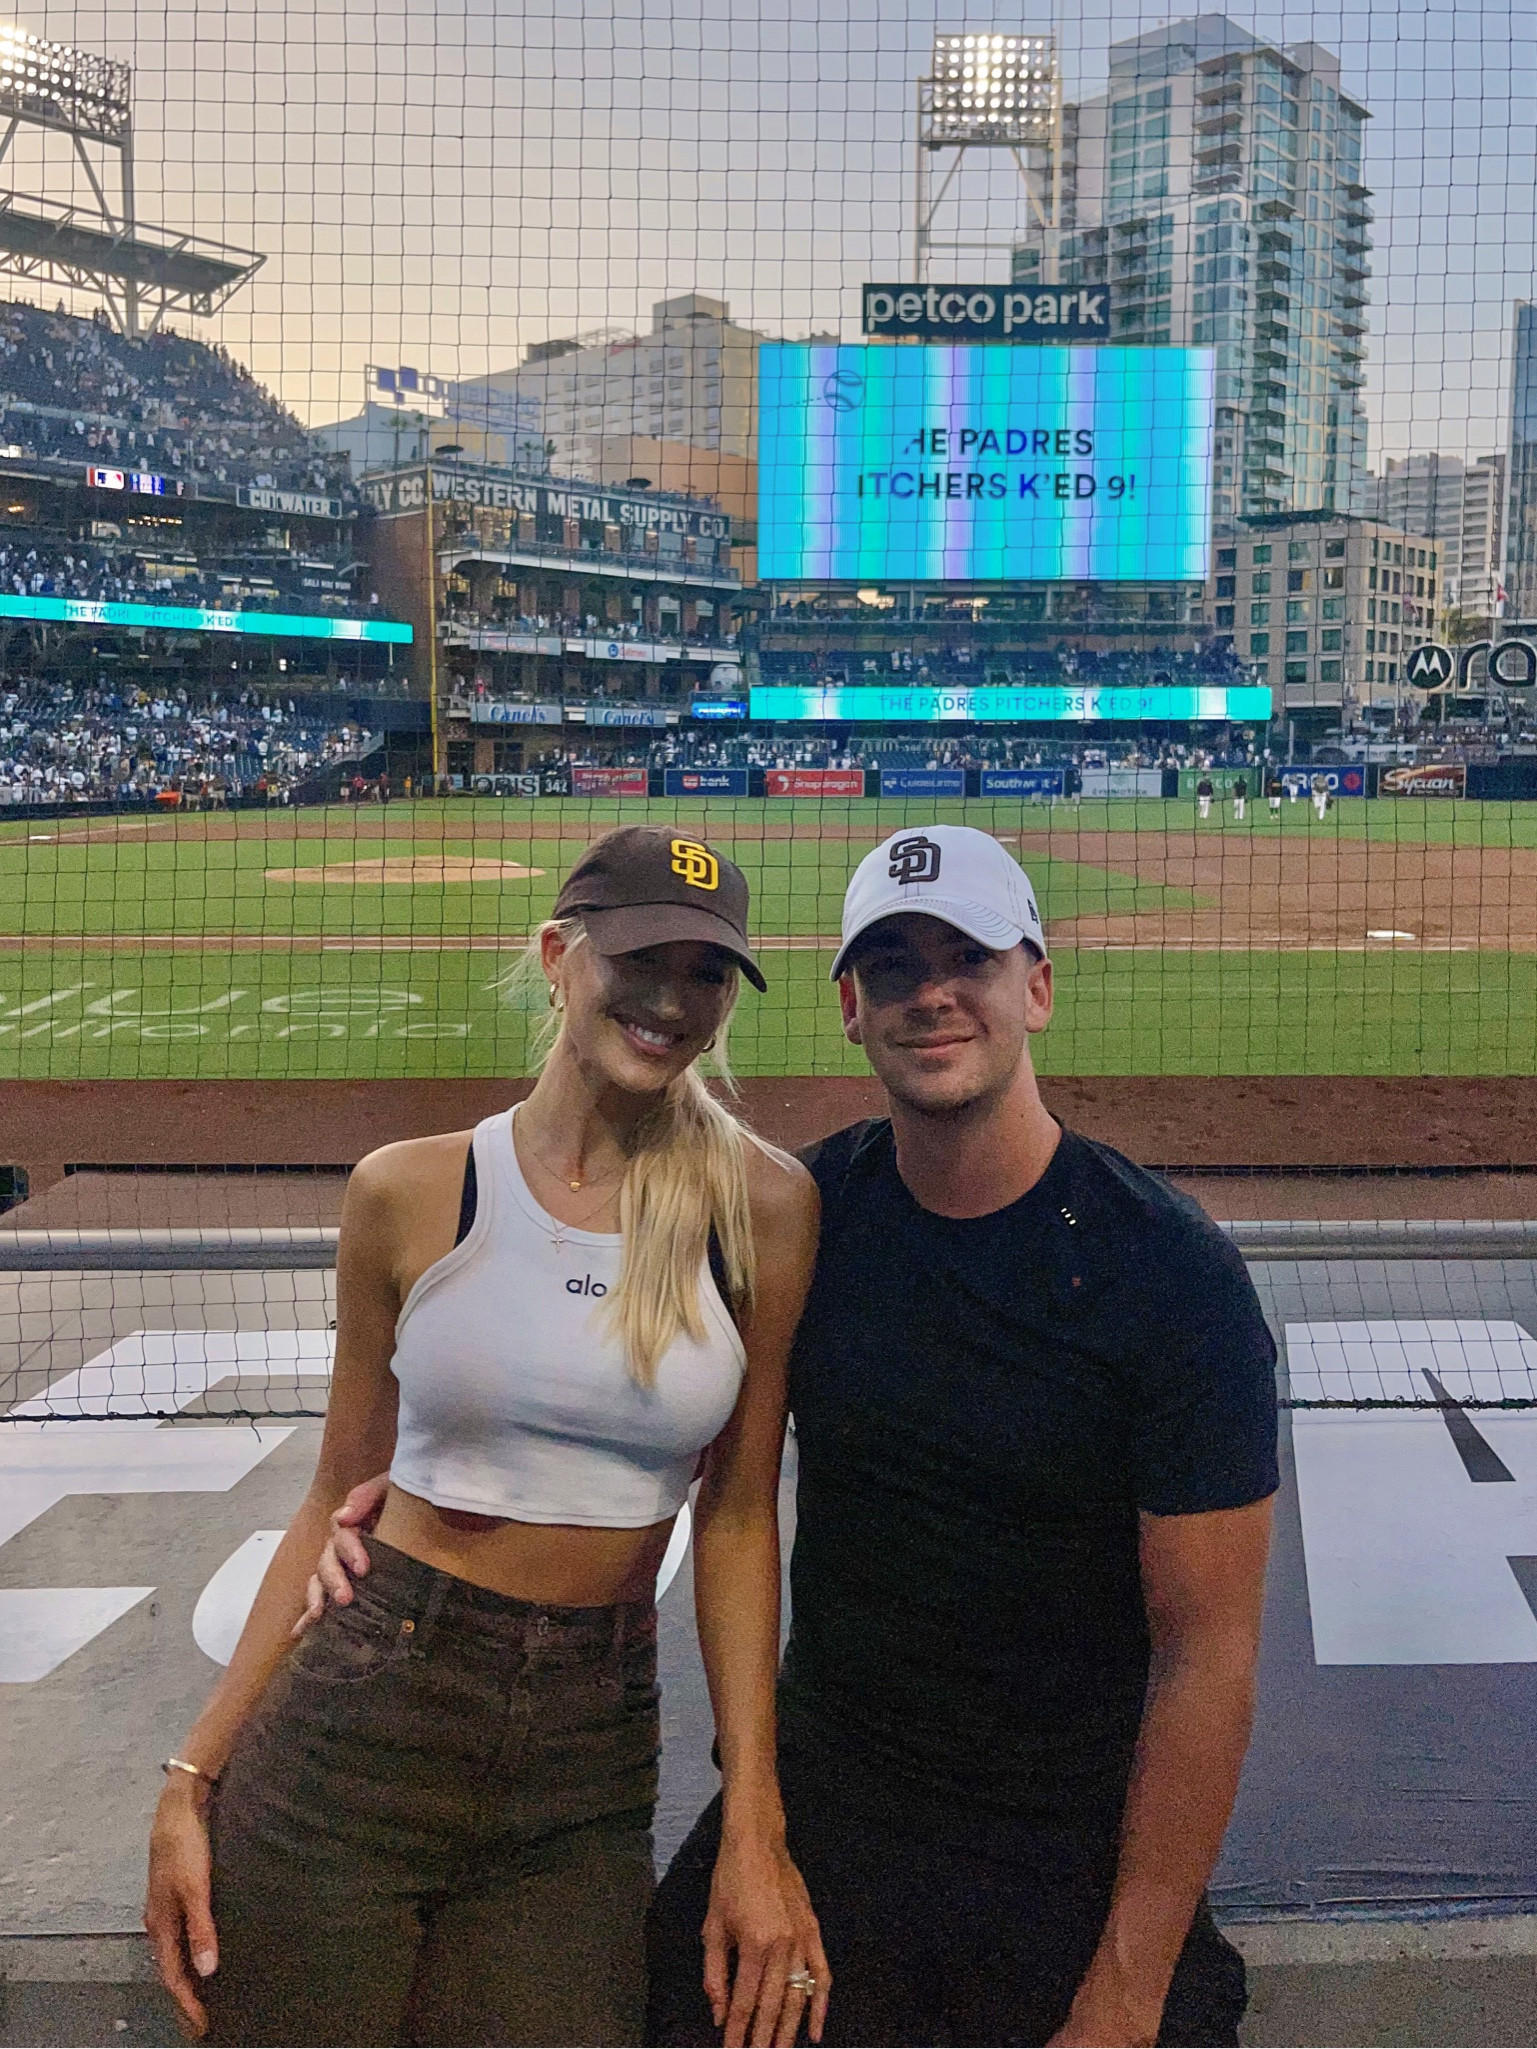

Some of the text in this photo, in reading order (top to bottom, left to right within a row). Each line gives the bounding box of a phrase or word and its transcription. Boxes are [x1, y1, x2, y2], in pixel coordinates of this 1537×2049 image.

[867, 287, 1106, 334] petco park
[959, 428, 1094, 455] PADRES
[1018, 473, 1096, 499] K'ED
[1107, 474, 1137, 499] 9!
[250, 489, 331, 516] CUTWATER
[432, 472, 729, 540] WESTERN METAL SUPPLY CO.
[879, 696, 912, 712] THE
[919, 697, 989, 712] PADRES
[995, 697, 1085, 712] PITCHERS
[475, 777, 537, 795] ORIS
[1384, 767, 1454, 794] Sycuan
[671, 839, 719, 891] SD
[889, 836, 941, 885] SD
[0, 982, 424, 1015] lue
[566, 1274, 607, 1297] alo
